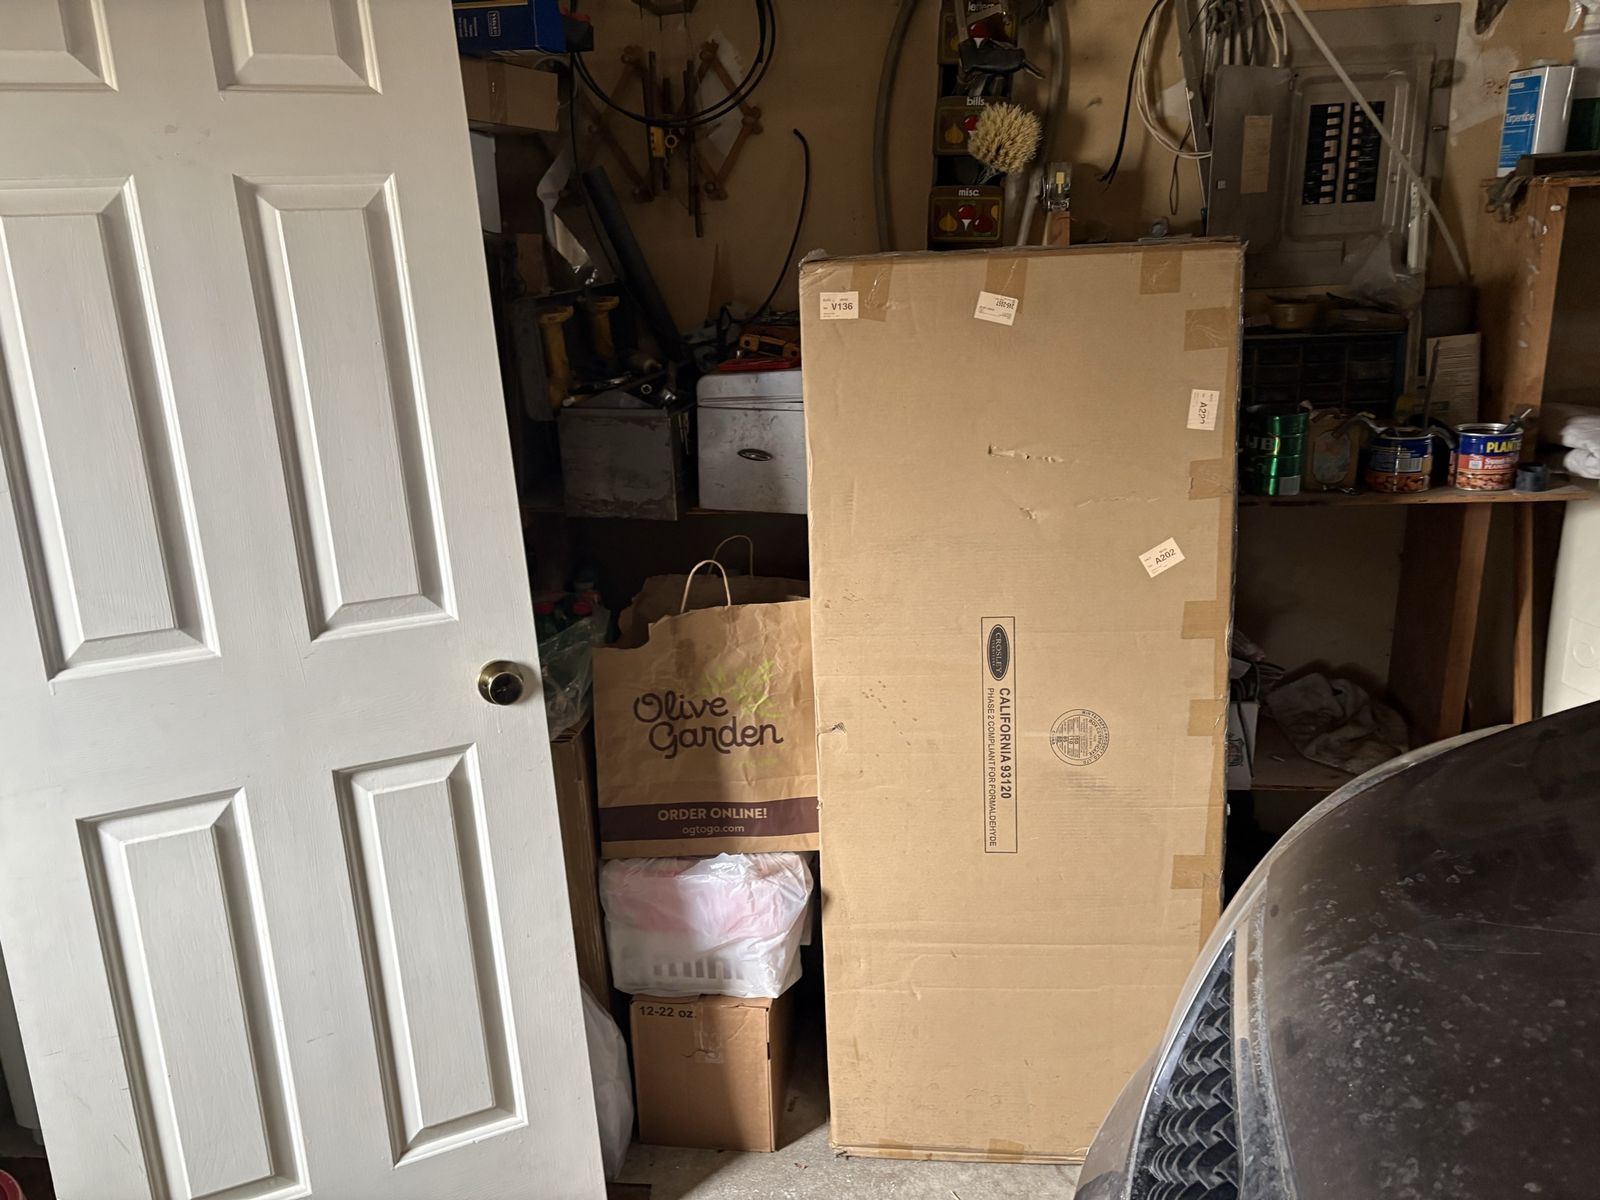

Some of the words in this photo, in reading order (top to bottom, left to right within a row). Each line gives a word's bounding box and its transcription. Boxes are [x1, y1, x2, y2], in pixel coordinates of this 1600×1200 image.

[966, 96, 985, 106] bills
[958, 187, 980, 197] misc
[831, 302, 854, 311] V136
[1155, 548, 1177, 565] A202
[995, 632, 1003, 674] CROSLEY
[633, 690, 729, 723] Olive
[987, 687, 995, 714] PHASE
[999, 687, 1012, 763] CALIFORNIA
[648, 716, 784, 759] Garden
[987, 721, 996, 765] COMPLIANT
[988, 766, 996, 783] FOR
[1000, 765, 1012, 799] 93120
[657, 807, 707, 821] ORDER
[709, 806, 768, 820] ONLINE!
[988, 784, 997, 847] FORMALDEHYDE
[682, 823, 745, 836] ogtogo.com
[639, 1005, 675, 1018] 12-22
